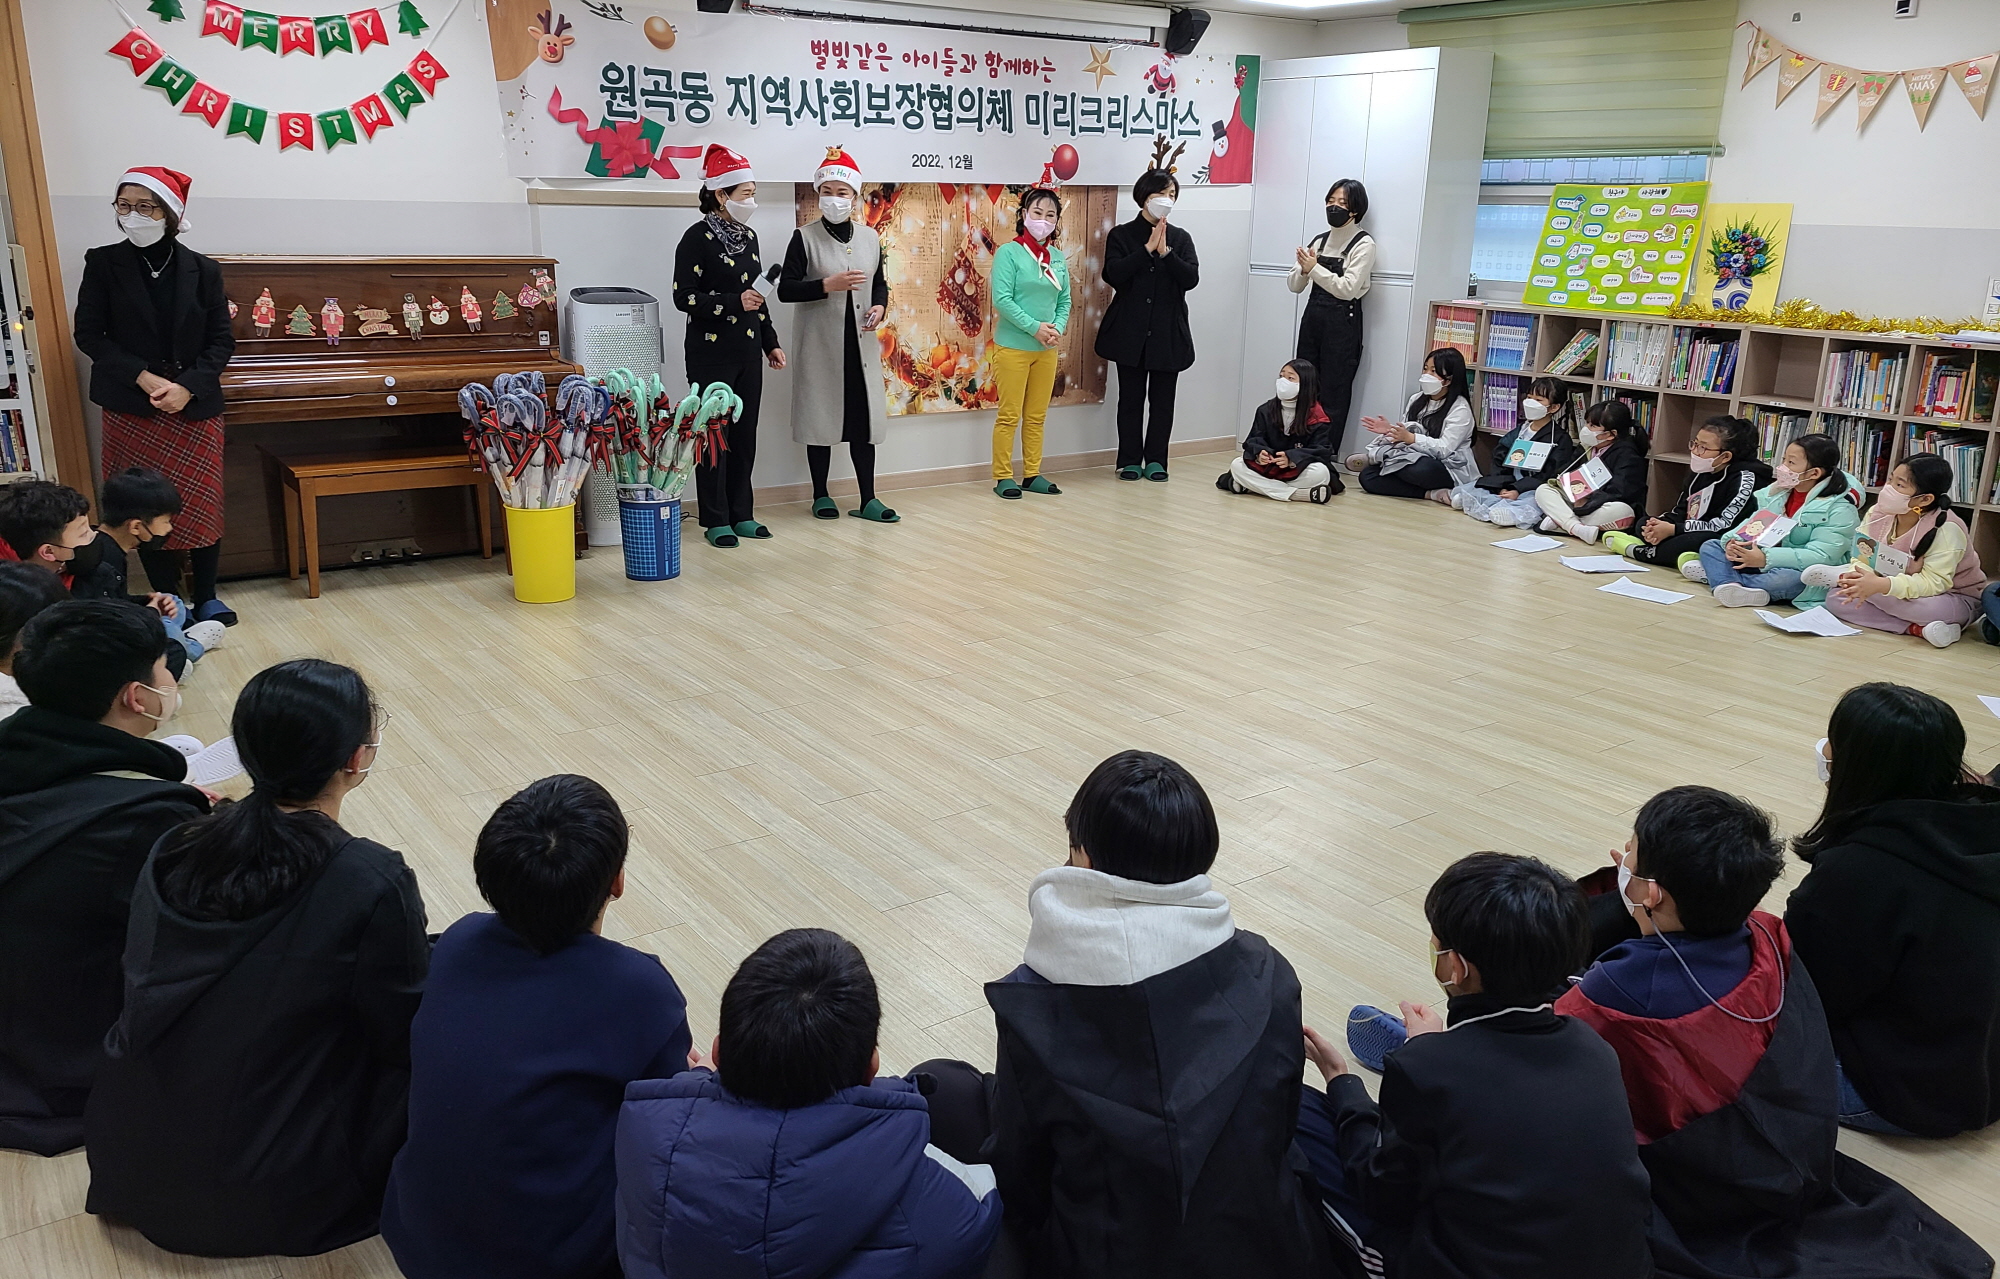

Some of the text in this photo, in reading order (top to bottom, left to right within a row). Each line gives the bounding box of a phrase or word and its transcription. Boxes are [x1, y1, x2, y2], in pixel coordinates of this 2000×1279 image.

[212, 6, 374, 43] MERRY
[810, 39, 1057, 83] 별빛같은 아이들과 함께하는
[1911, 73, 1933, 81] MERRY
[130, 39, 436, 138] CHRISTMAS
[600, 61, 1202, 139] 원곡동 지역사회보장협의체 미리크리스마스
[1908, 79, 1935, 92] XMAS
[948, 154, 974, 170] 12월
